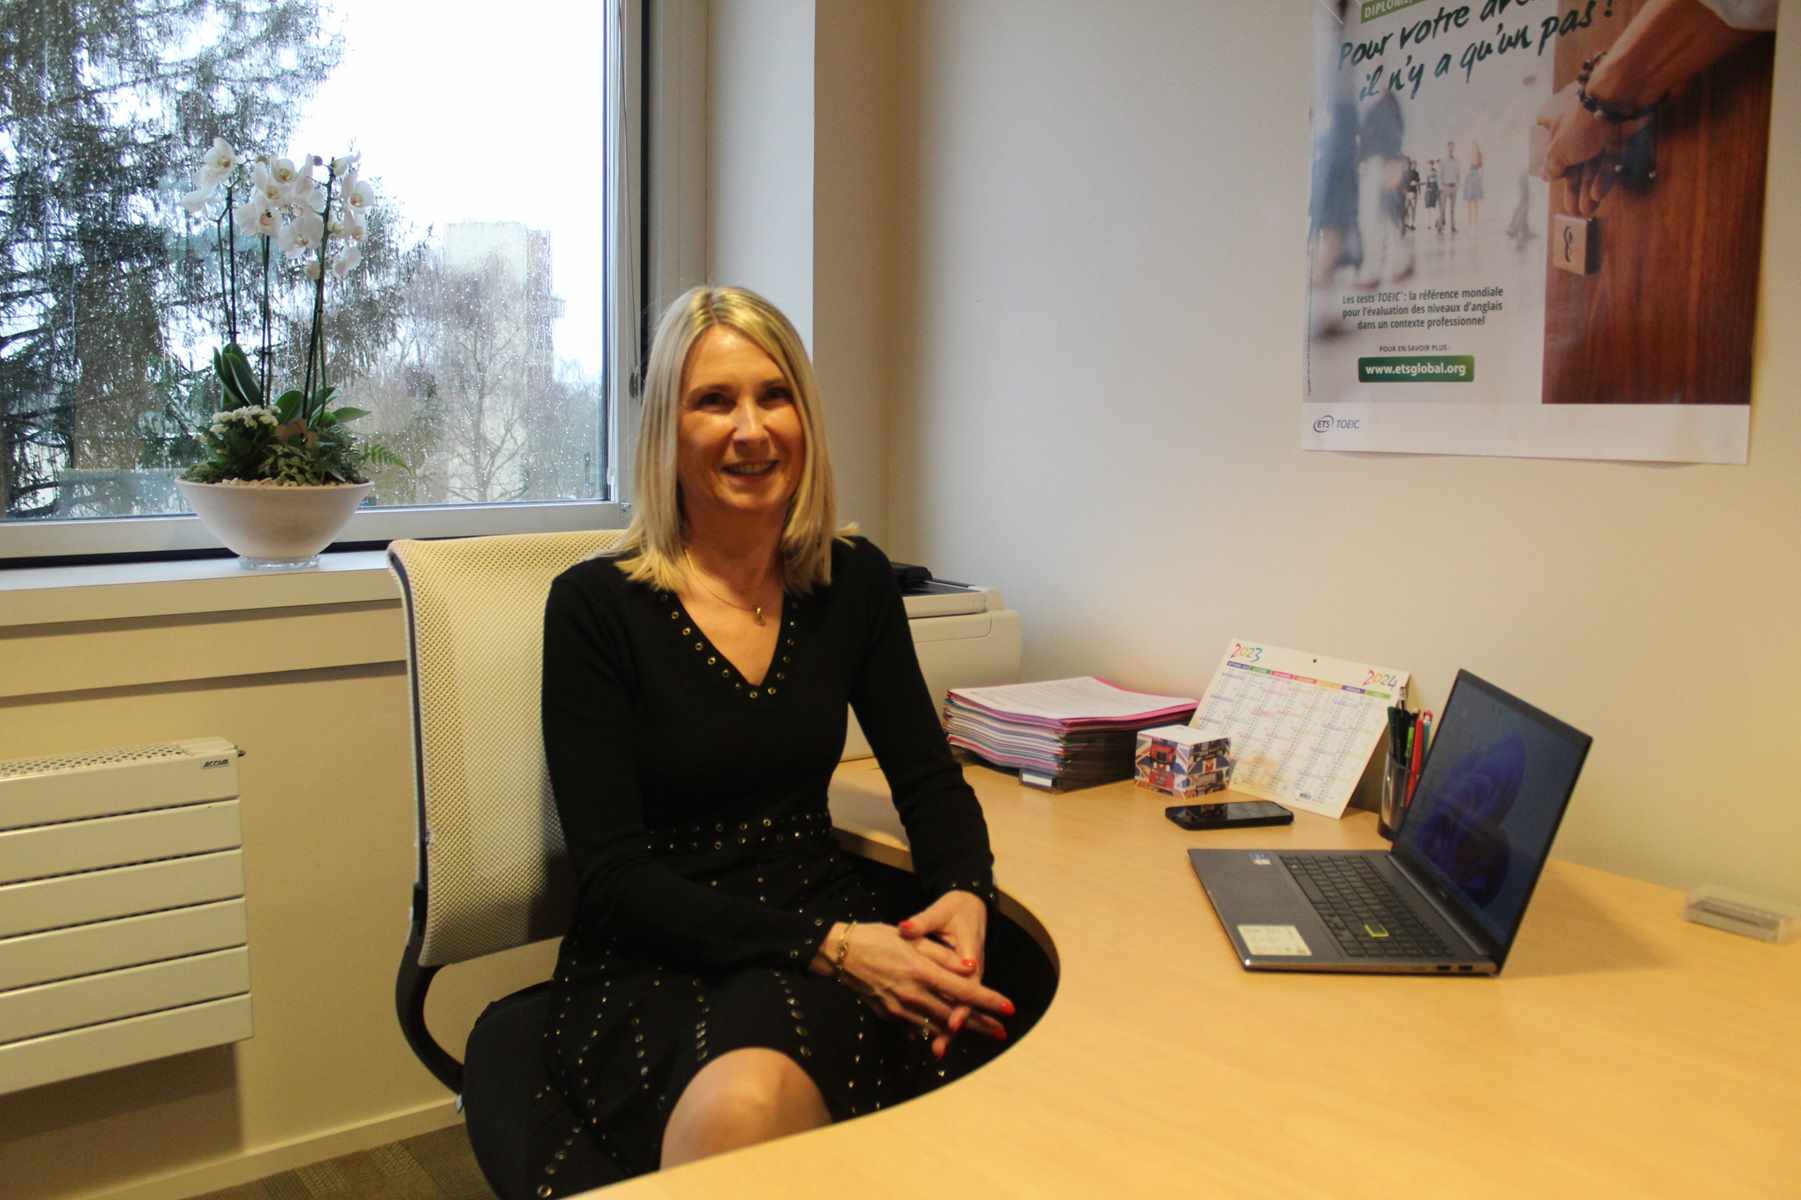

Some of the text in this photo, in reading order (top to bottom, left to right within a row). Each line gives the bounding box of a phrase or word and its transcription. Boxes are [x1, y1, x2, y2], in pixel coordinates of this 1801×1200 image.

[1338, 32, 1394, 71] Pour
[1399, 6, 1470, 50] votre
[1360, 64, 1384, 101] il
[1434, 53, 1452, 78] a
[1342, 295, 1355, 305] Les
[1357, 294, 1375, 304] tests
[1408, 290, 1417, 301] la
[1419, 288, 1459, 301] référence
[1462, 285, 1504, 298] mondiale
[1342, 309, 1361, 320] pour
[1411, 303, 1426, 314] des
[1427, 302, 1461, 313] niveaux
[1463, 300, 1504, 314] d'anglais
[1358, 315, 1486, 330] dans un contexte professionnel
[1365, 362, 1467, 377] www.etsglobal.org
